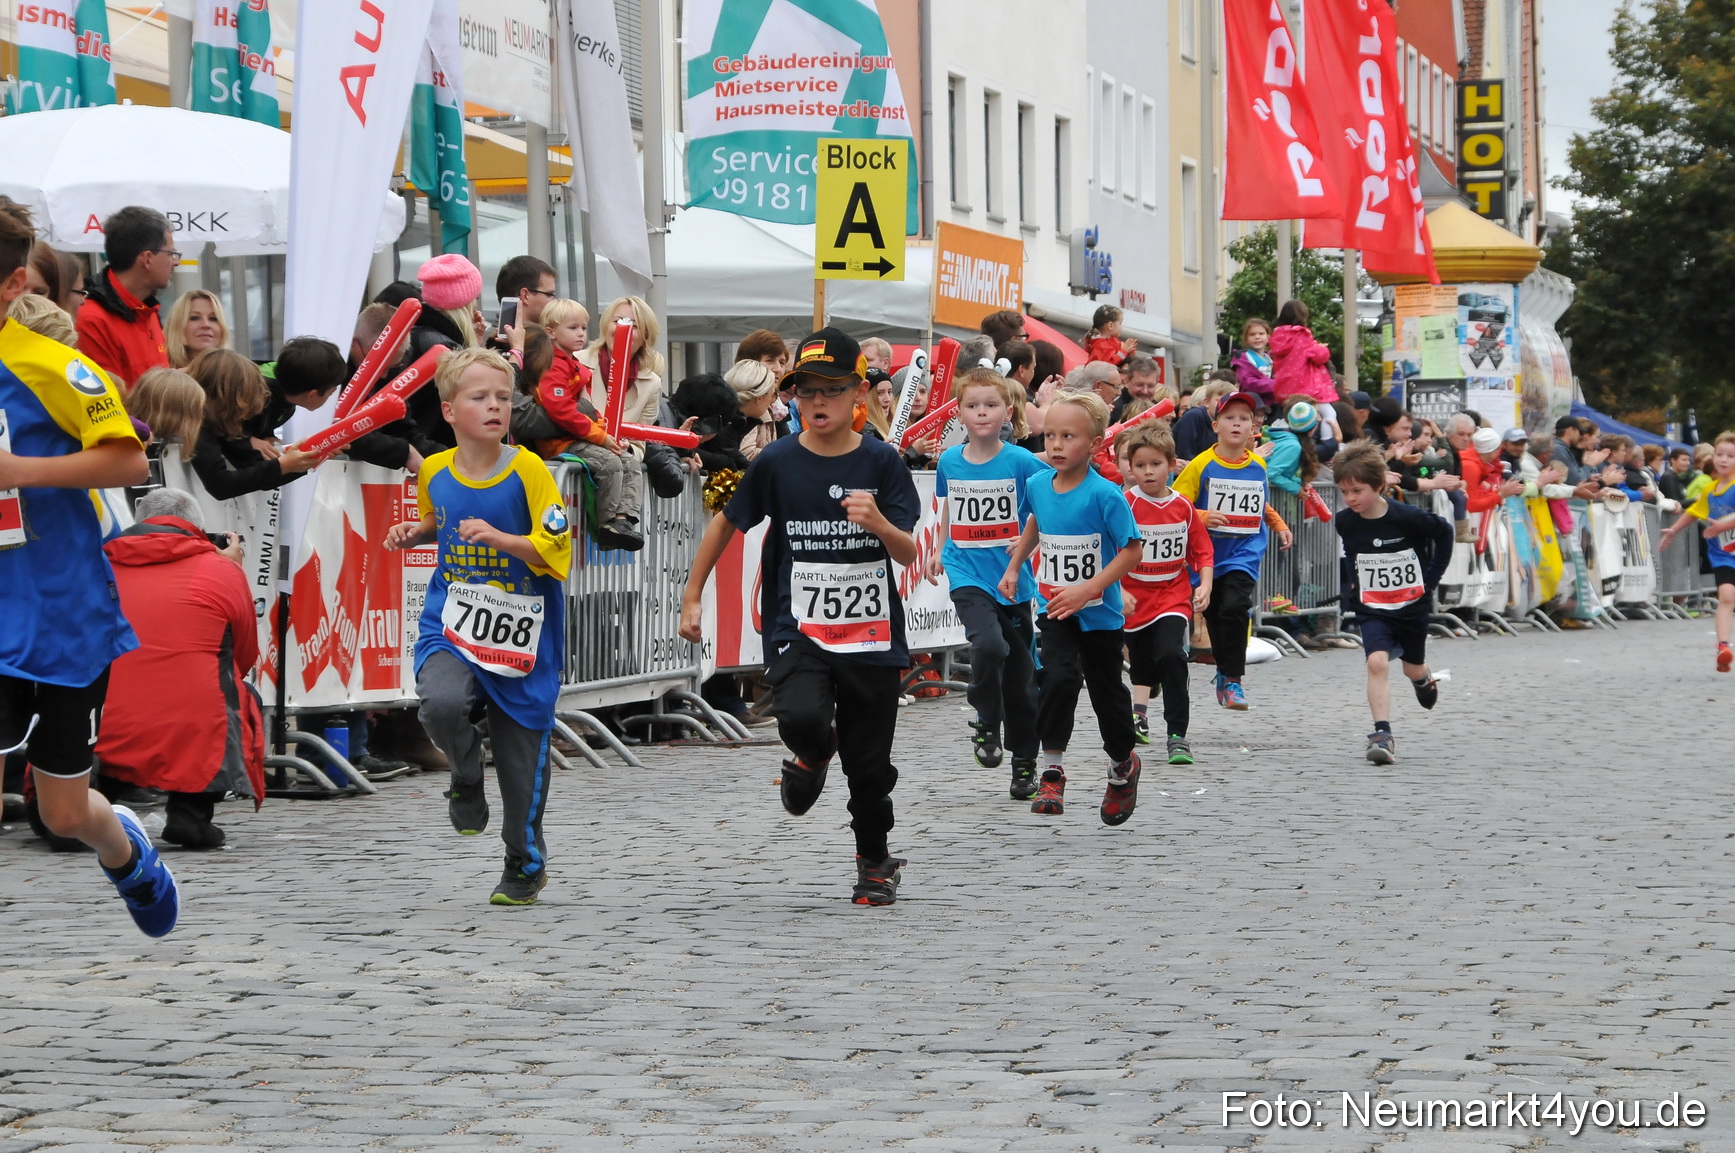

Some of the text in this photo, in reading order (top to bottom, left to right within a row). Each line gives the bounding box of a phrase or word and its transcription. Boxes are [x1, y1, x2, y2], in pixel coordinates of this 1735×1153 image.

[714, 77, 839, 98] Mietservice
[715, 99, 905, 121] Hausmeisterdienst
[827, 144, 897, 170] Block
[833, 181, 886, 249] A
[353, 360, 370, 382] BKK
[308, 428, 349, 452] Audi BKK
[908, 416, 944, 443] Audi BKK
[969, 486, 1004, 494] Neumarkt
[954, 496, 1011, 522] 7029
[1215, 492, 1260, 513] 7143
[968, 528, 997, 539] Lukas
[1051, 543, 1090, 551] Neumarkt
[793, 571, 873, 582] PARTL Neumarkt
[1042, 553, 1096, 582] 7158
[1364, 563, 1417, 588] 7538
[406, 581, 428, 592] Braun
[406, 596, 417, 606] Am
[449, 585, 527, 612] PARTL Neumarkt
[802, 584, 882, 620] 7523
[453, 600, 534, 648] 7068
[822, 626, 849, 640] Paul
